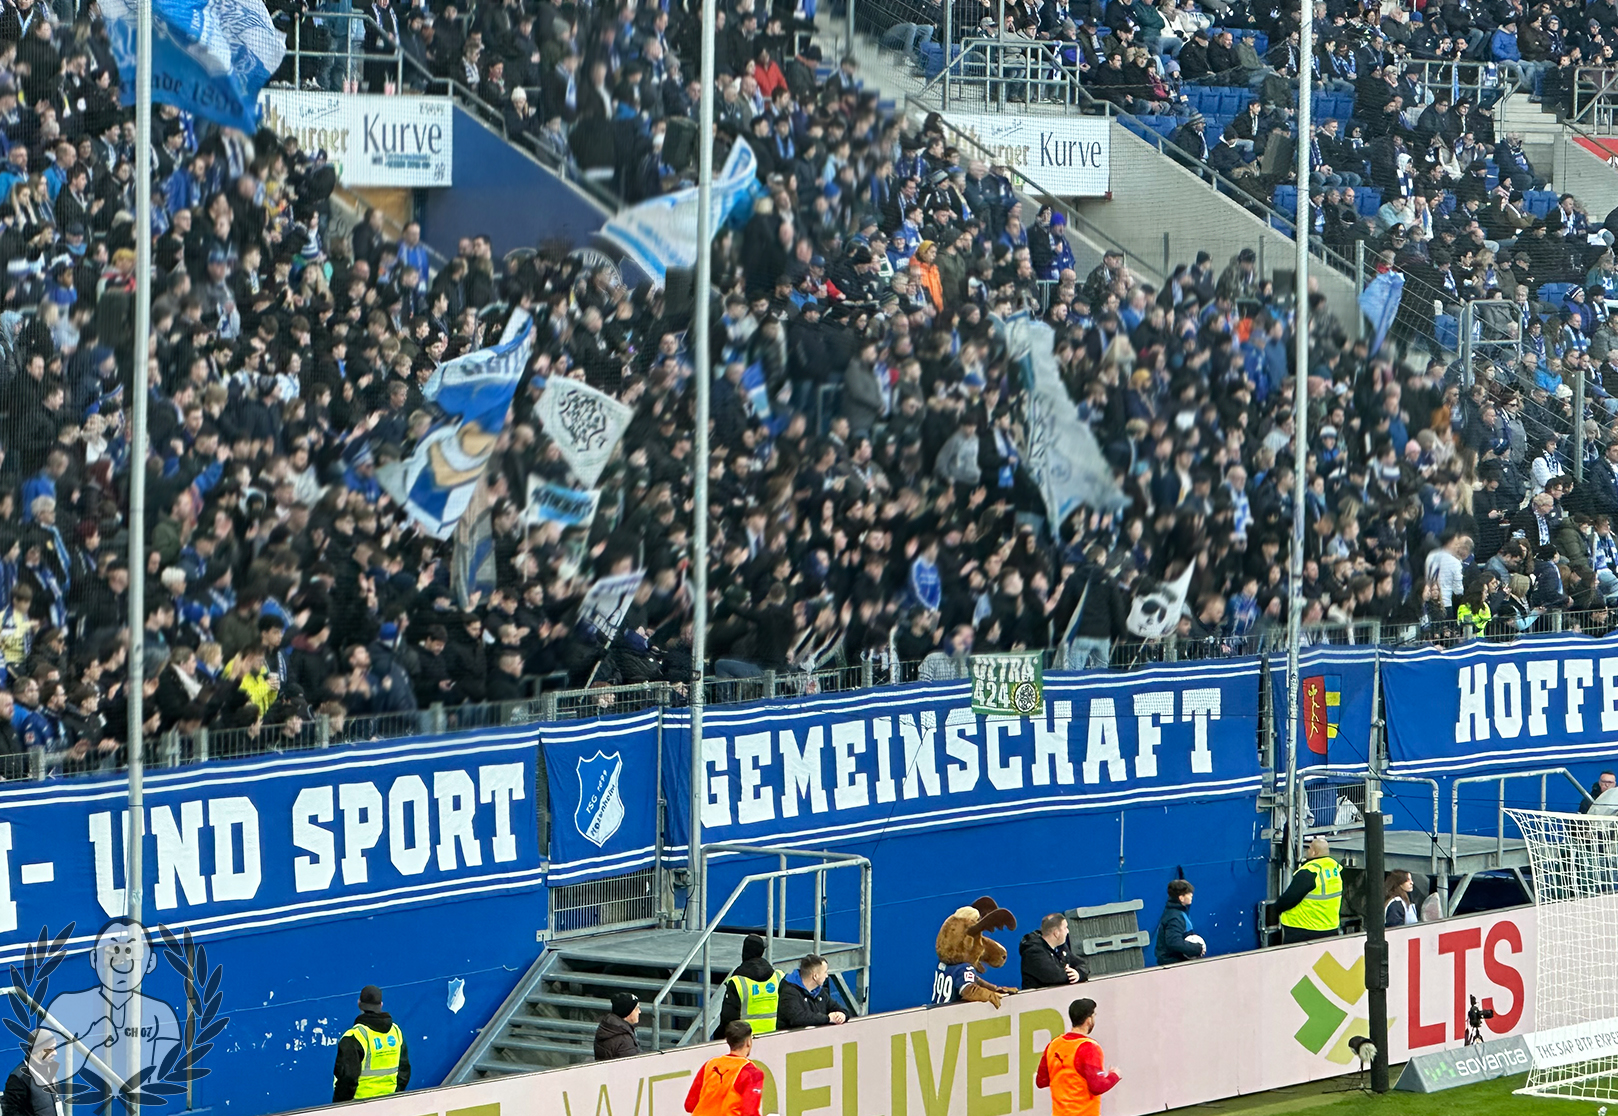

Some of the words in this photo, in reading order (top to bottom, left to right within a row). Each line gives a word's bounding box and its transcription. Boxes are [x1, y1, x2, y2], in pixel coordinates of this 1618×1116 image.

[363, 112, 442, 154] Kurve
[1040, 131, 1102, 168] Kurve
[973, 680, 1011, 708] 424
[700, 687, 1221, 829] GEMEINSCHAFT
[88, 796, 262, 919] UND
[292, 761, 526, 893] SPORT
[1408, 920, 1525, 1050] LTS
[1456, 1047, 1529, 1077] sovanta
[1535, 1043, 1558, 1059] THE
[1555, 1039, 1575, 1057] SAP
